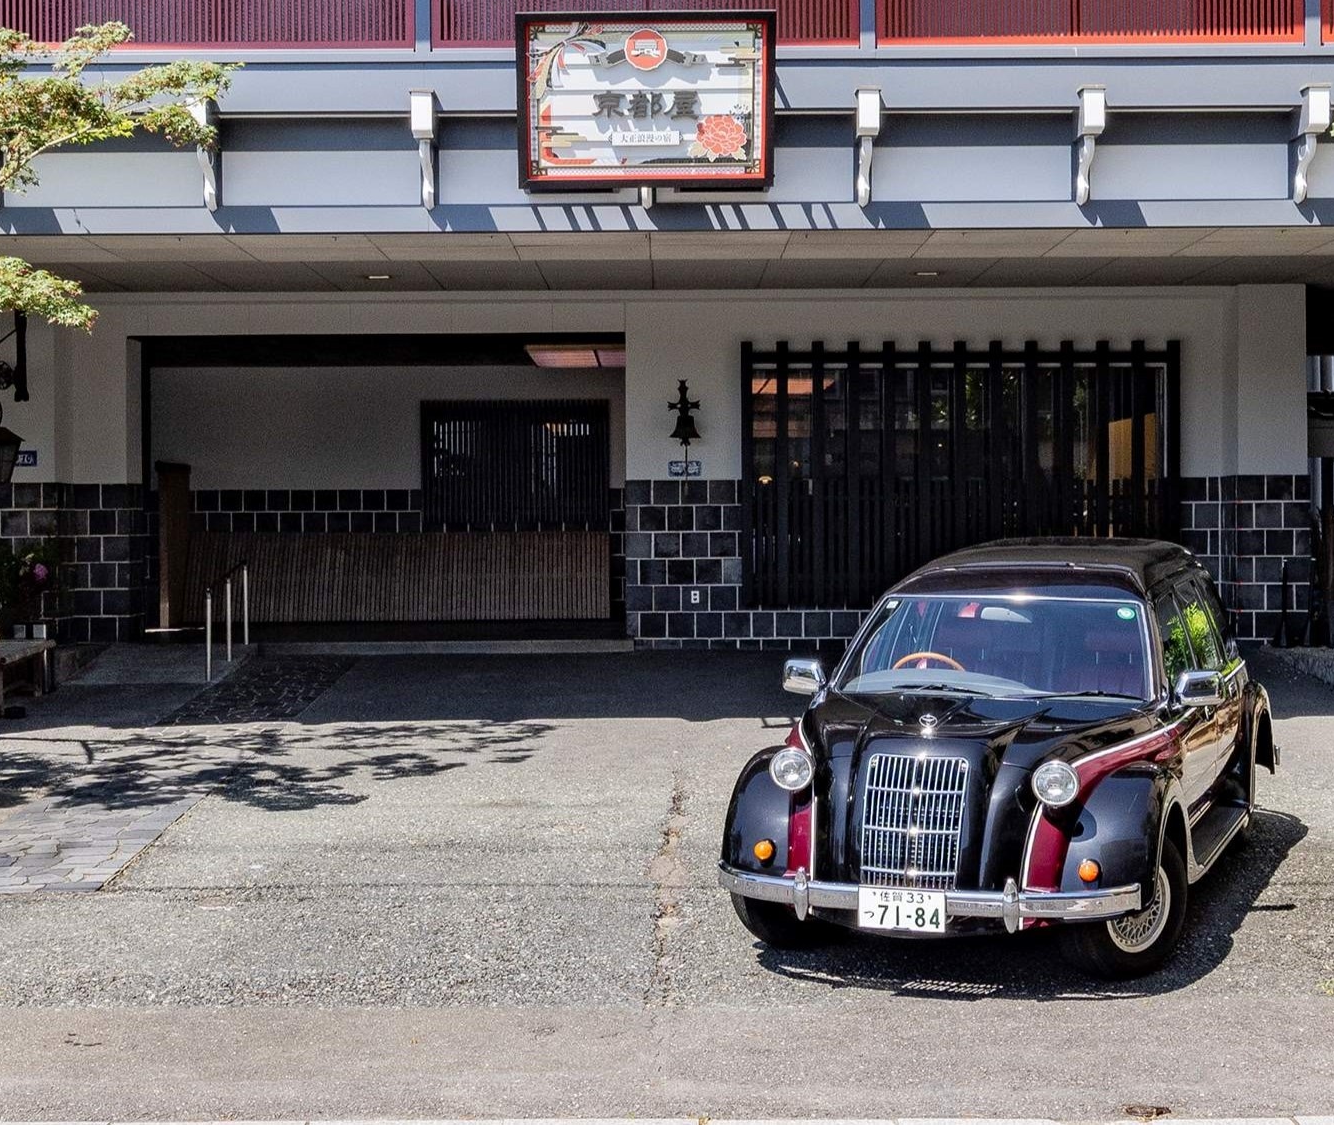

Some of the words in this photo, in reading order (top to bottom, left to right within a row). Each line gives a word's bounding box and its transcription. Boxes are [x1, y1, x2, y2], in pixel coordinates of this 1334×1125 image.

[592, 90, 699, 120] 京都屋
[878, 904, 940, 929] 71-84
